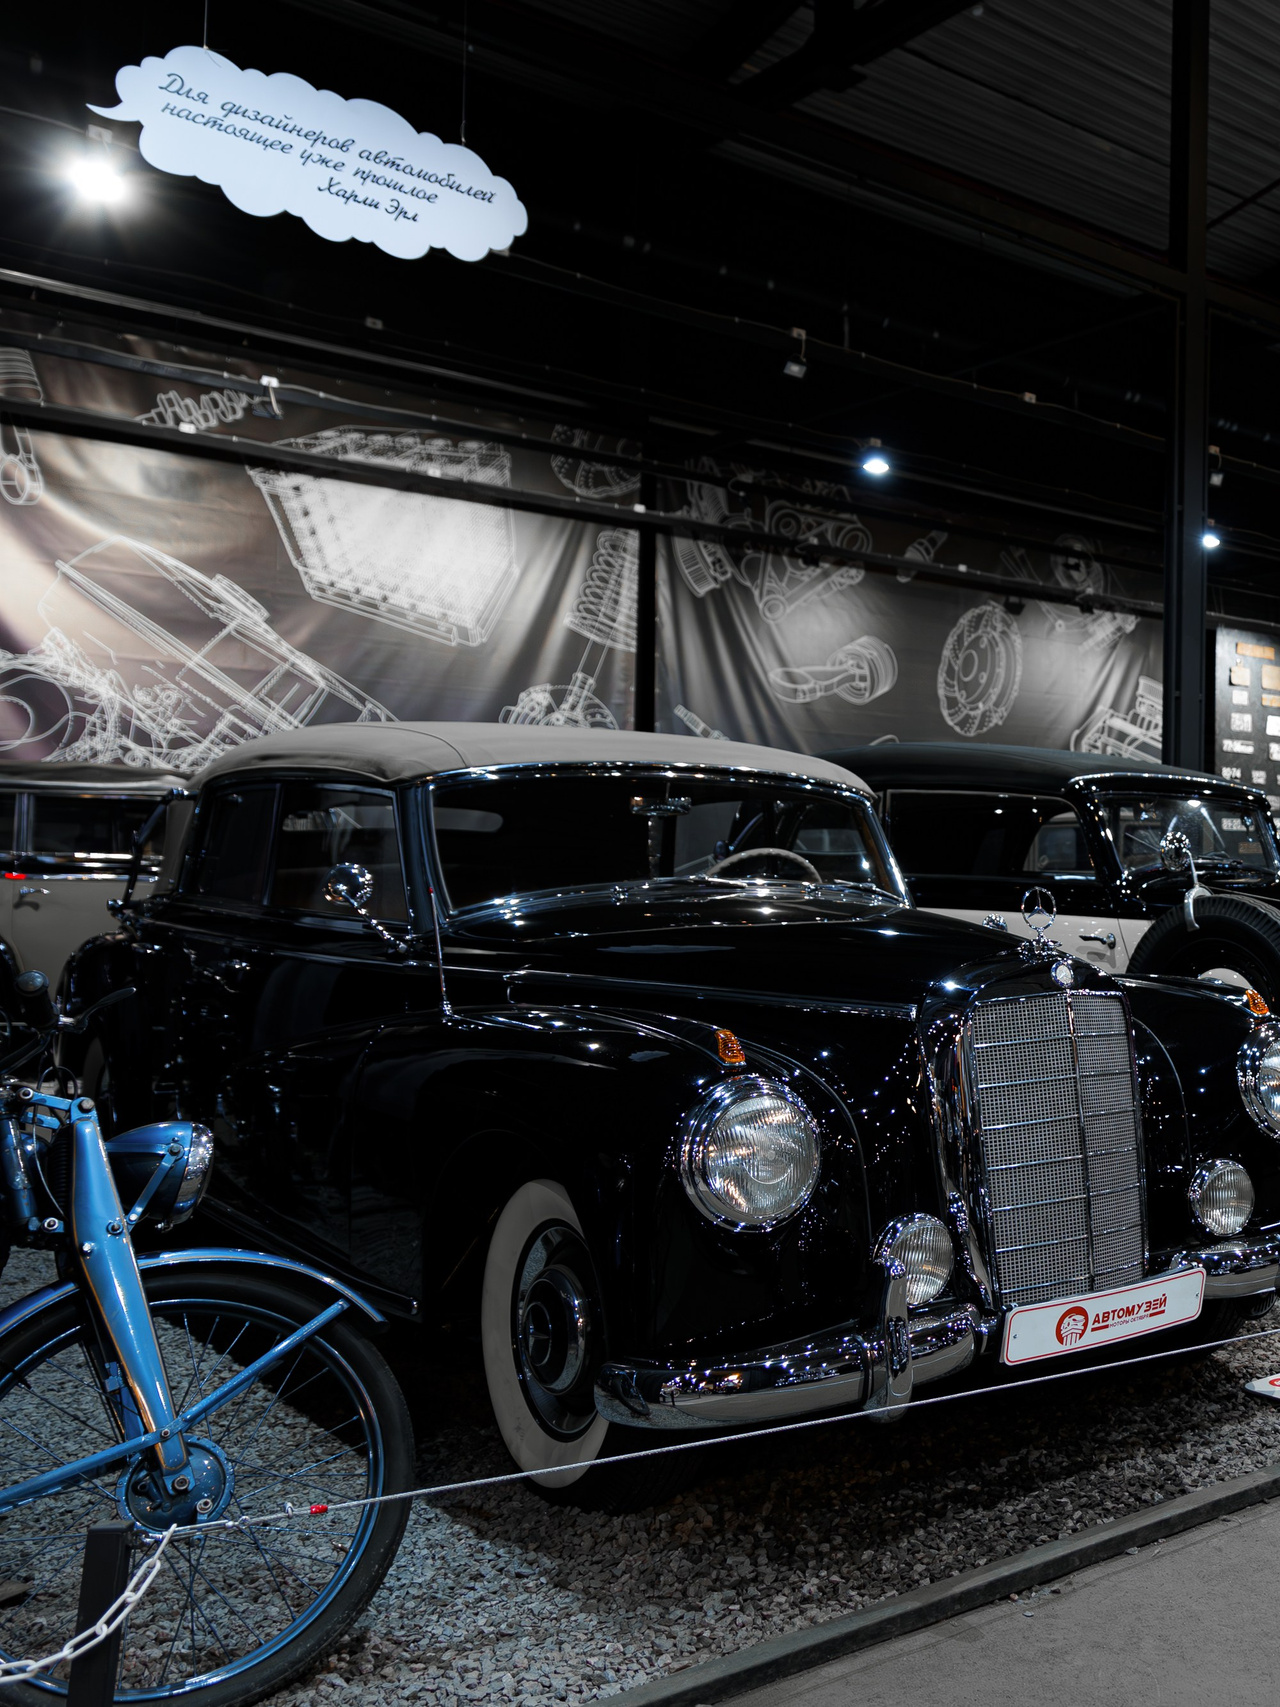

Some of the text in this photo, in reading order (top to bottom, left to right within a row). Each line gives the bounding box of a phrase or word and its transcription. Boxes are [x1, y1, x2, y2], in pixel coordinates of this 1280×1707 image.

[158, 72, 498, 204] Для дизайнеров автомобилей
[161, 101, 440, 205] настоящее уже прошлое
[317, 177, 419, 224] Харли Эрл
[1092, 1293, 1167, 1326] АВТОМУЗЕЙ
